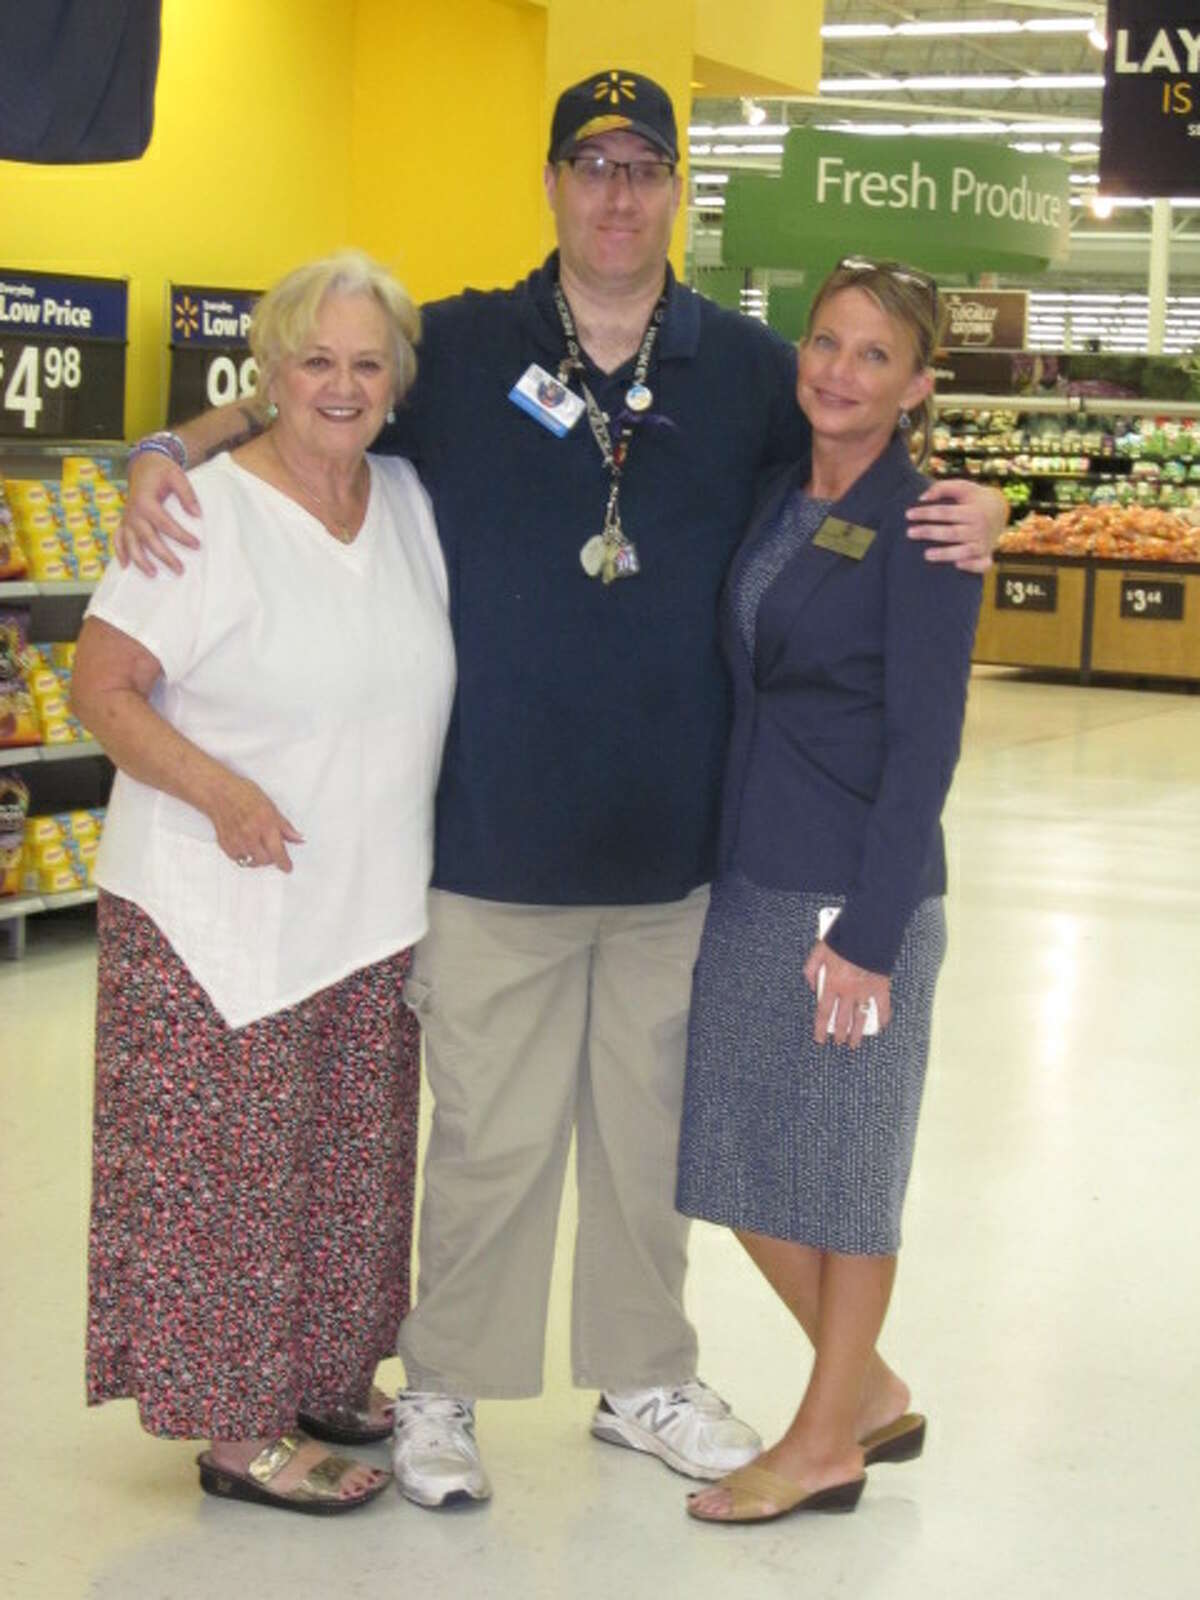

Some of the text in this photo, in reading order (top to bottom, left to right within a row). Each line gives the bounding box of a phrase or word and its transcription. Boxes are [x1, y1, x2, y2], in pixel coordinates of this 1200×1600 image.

[1115, 27, 1200, 73] LAY
[1163, 81, 1192, 114] IS
[816, 157, 1063, 228] Fresh Produce
[0, 294, 92, 328] Low Price
[203, 311, 238, 336] Low
